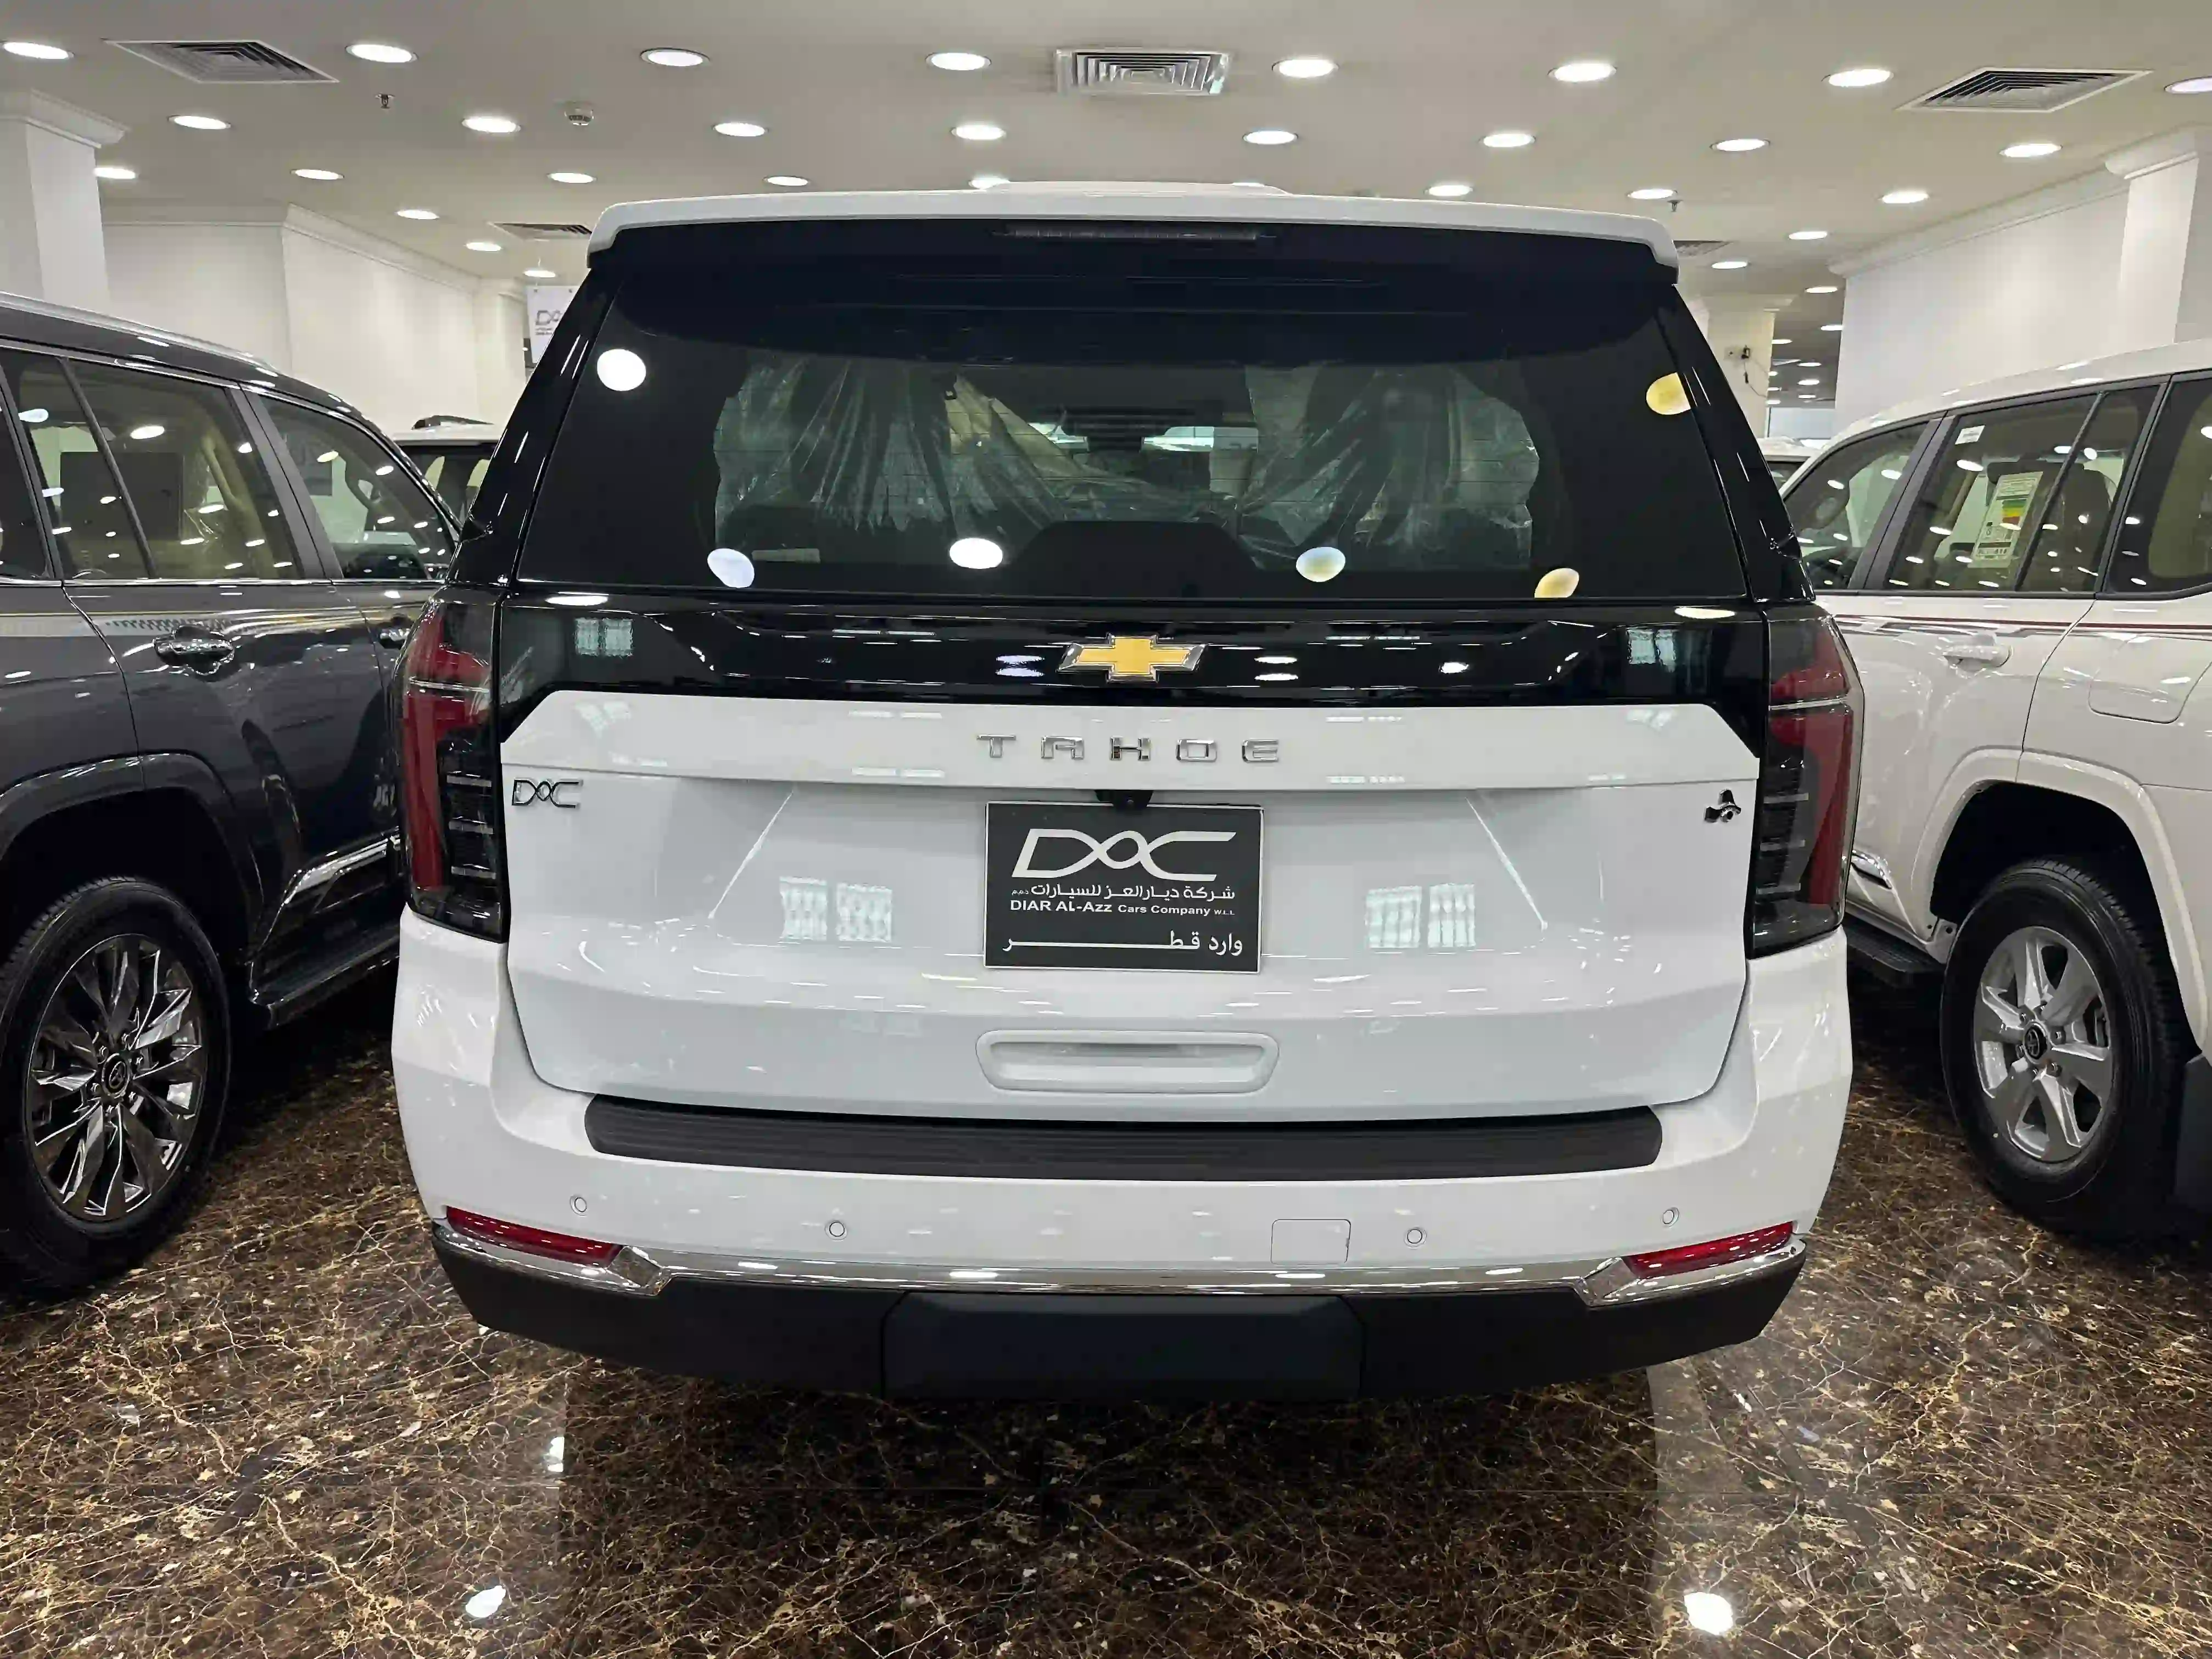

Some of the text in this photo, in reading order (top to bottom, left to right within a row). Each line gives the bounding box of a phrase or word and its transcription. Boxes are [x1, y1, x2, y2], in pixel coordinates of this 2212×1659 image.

[976, 734, 1280, 763] TAHOE
[1030, 883, 1102, 899] للسيارات
[1183, 885, 1235, 902] شركة
[1010, 900, 1053, 911] DIAR
[1118, 904, 1147, 913] Cars
[1150, 905, 1211, 917] Company
[1209, 933, 1243, 956] وارد
